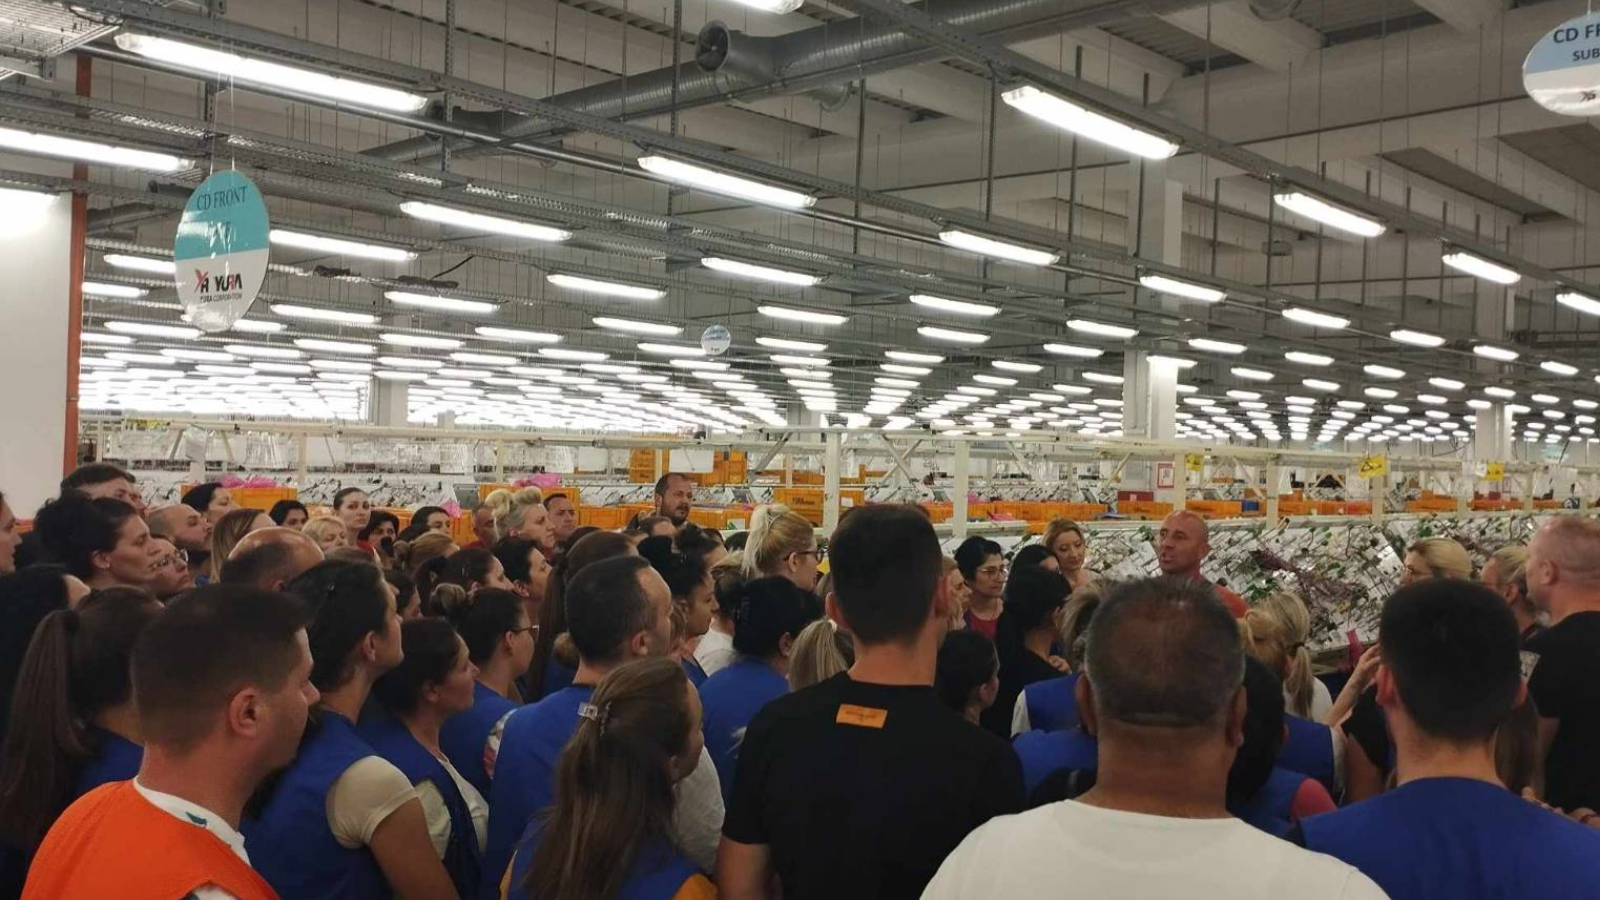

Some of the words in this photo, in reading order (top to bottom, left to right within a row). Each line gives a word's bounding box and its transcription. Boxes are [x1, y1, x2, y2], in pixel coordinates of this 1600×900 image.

[1553, 27, 1579, 44] CD
[196, 193, 211, 211] CD
[213, 185, 248, 209] FRONT
